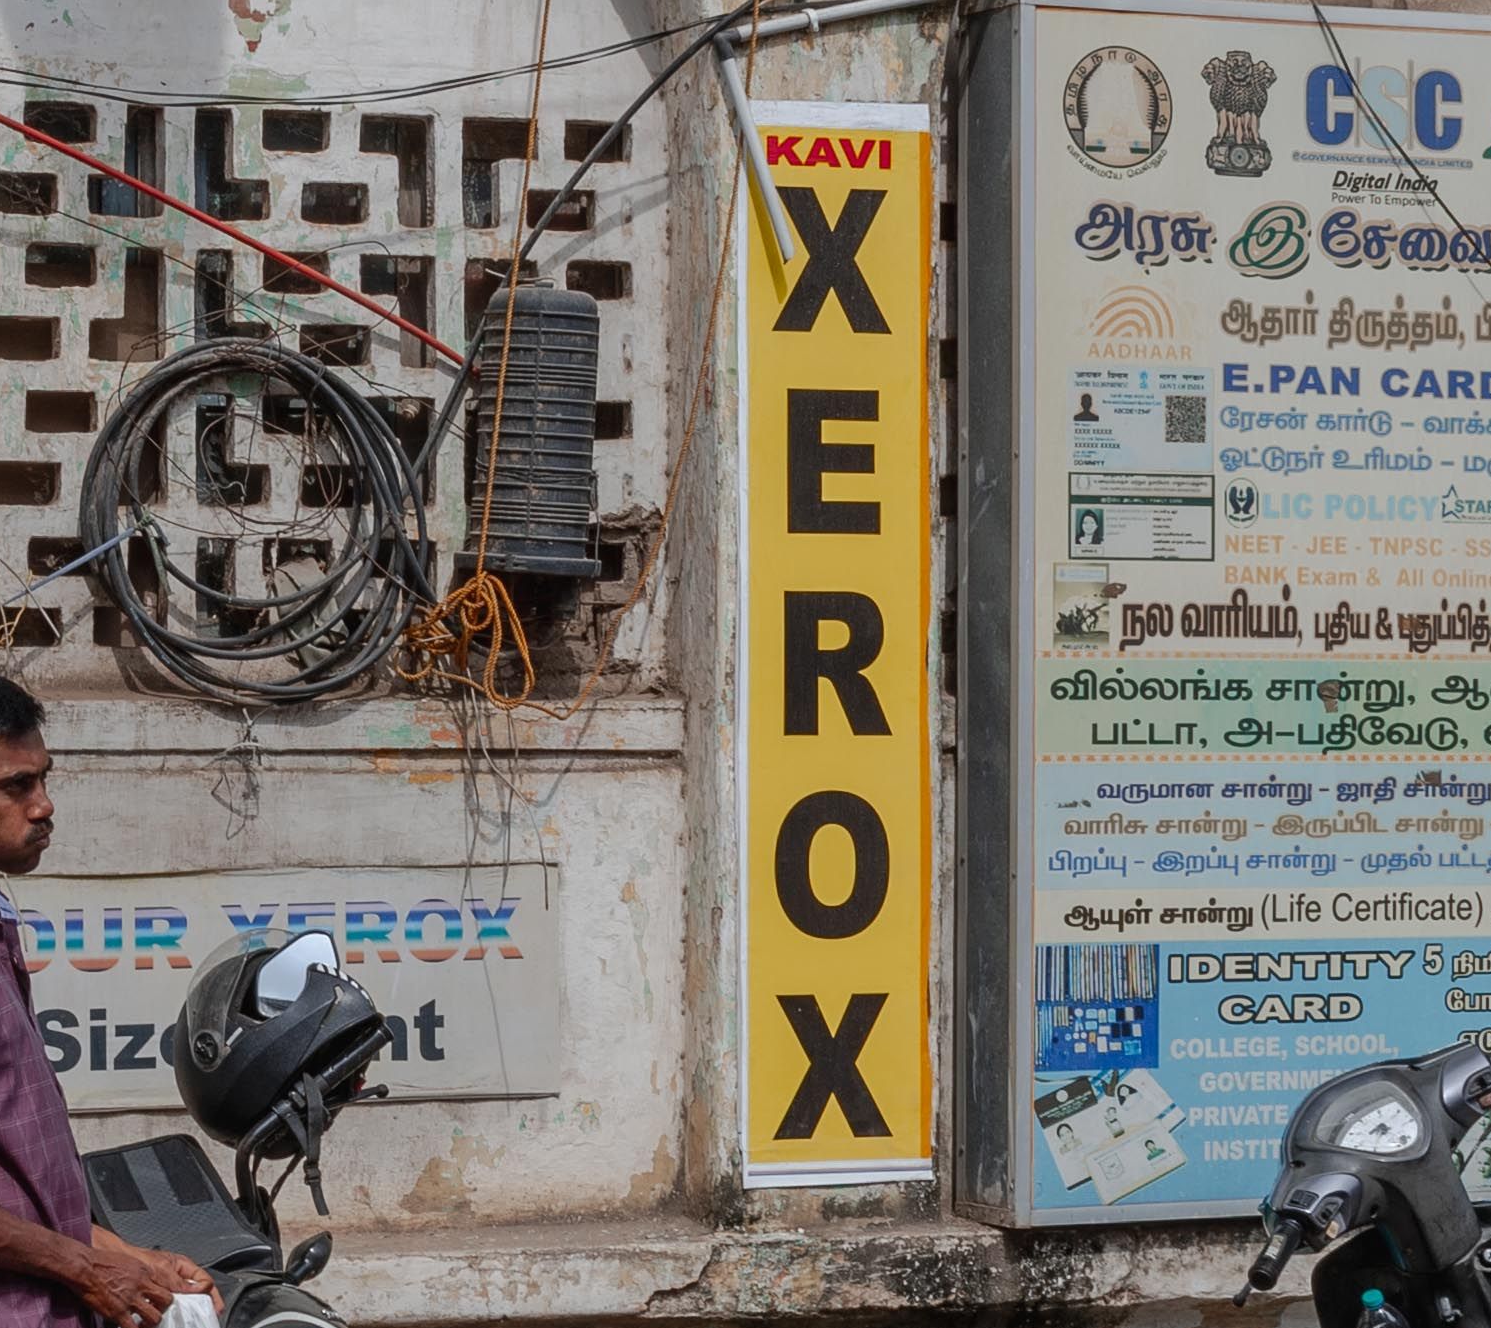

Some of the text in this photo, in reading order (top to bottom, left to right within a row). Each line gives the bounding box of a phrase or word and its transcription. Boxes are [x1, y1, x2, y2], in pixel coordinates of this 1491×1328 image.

[1306, 65, 1464, 151] CSC
[765, 135, 893, 171] KAVI
[1331, 170, 1439, 193] Digital India
[1331, 192, 1437, 208] Power To Empower
[1074, 201, 1216, 269] அரசு
[1221, 289, 1319, 347] ஆதார்
[1087, 342, 1193, 361] AADHAAR
[1221, 363, 1361, 397] E.PAN
[1262, 493, 1313, 520] LIC
[1324, 493, 1441, 522] POLICY
[1224, 535, 1285, 555] NEET
[1306, 537, 1347, 556] JEE
[1369, 537, 1443, 557] TNPSC
[1224, 566, 1288, 586] BANK
[1296, 566, 1358, 587] Exam
[1366, 569, 1382, 587] &
[1396, 568, 1425, 588] All
[1375, 607, 1393, 640] &
[772, 186, 893, 1141] XEROX
[1050, 667, 1253, 703] வில்லங்க
[1096, 782, 1215, 805] வருமான
[1220, 774, 1312, 806] சான்று
[1335, 776, 1397, 805] ஜாதி
[1245, 845, 1336, 876] சான்று
[1063, 897, 1154, 933] ஆயுள்
[1159, 897, 1254, 932] சான்று
[1261, 892, 1322, 931] (Life
[1331, 891, 1484, 928] Certificate)
[1167, 950, 1416, 983] IDENTITY
[1422, 943, 1443, 976] 5
[1217, 993, 1364, 1026] CARD
[1169, 1033, 1400, 1062] COLLEGE, SCHOOL,
[1188, 1104, 1289, 1129] PRIVATE
